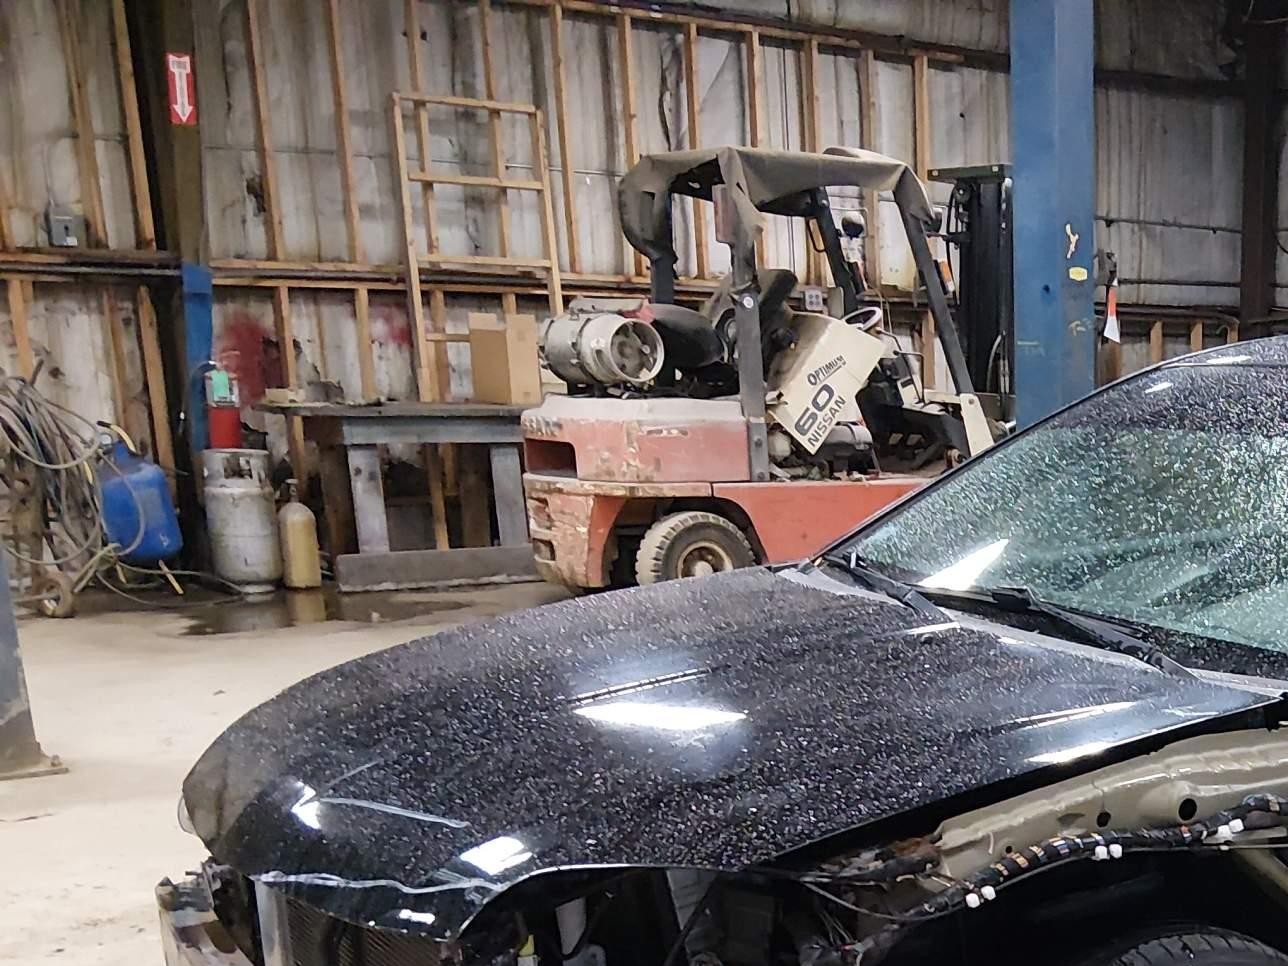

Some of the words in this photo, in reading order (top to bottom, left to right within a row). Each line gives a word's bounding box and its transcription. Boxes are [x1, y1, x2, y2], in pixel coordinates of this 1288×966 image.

[807, 354, 847, 386] OPTIMUM
[794, 383, 835, 437] 60
[807, 395, 846, 447] NISSAN
